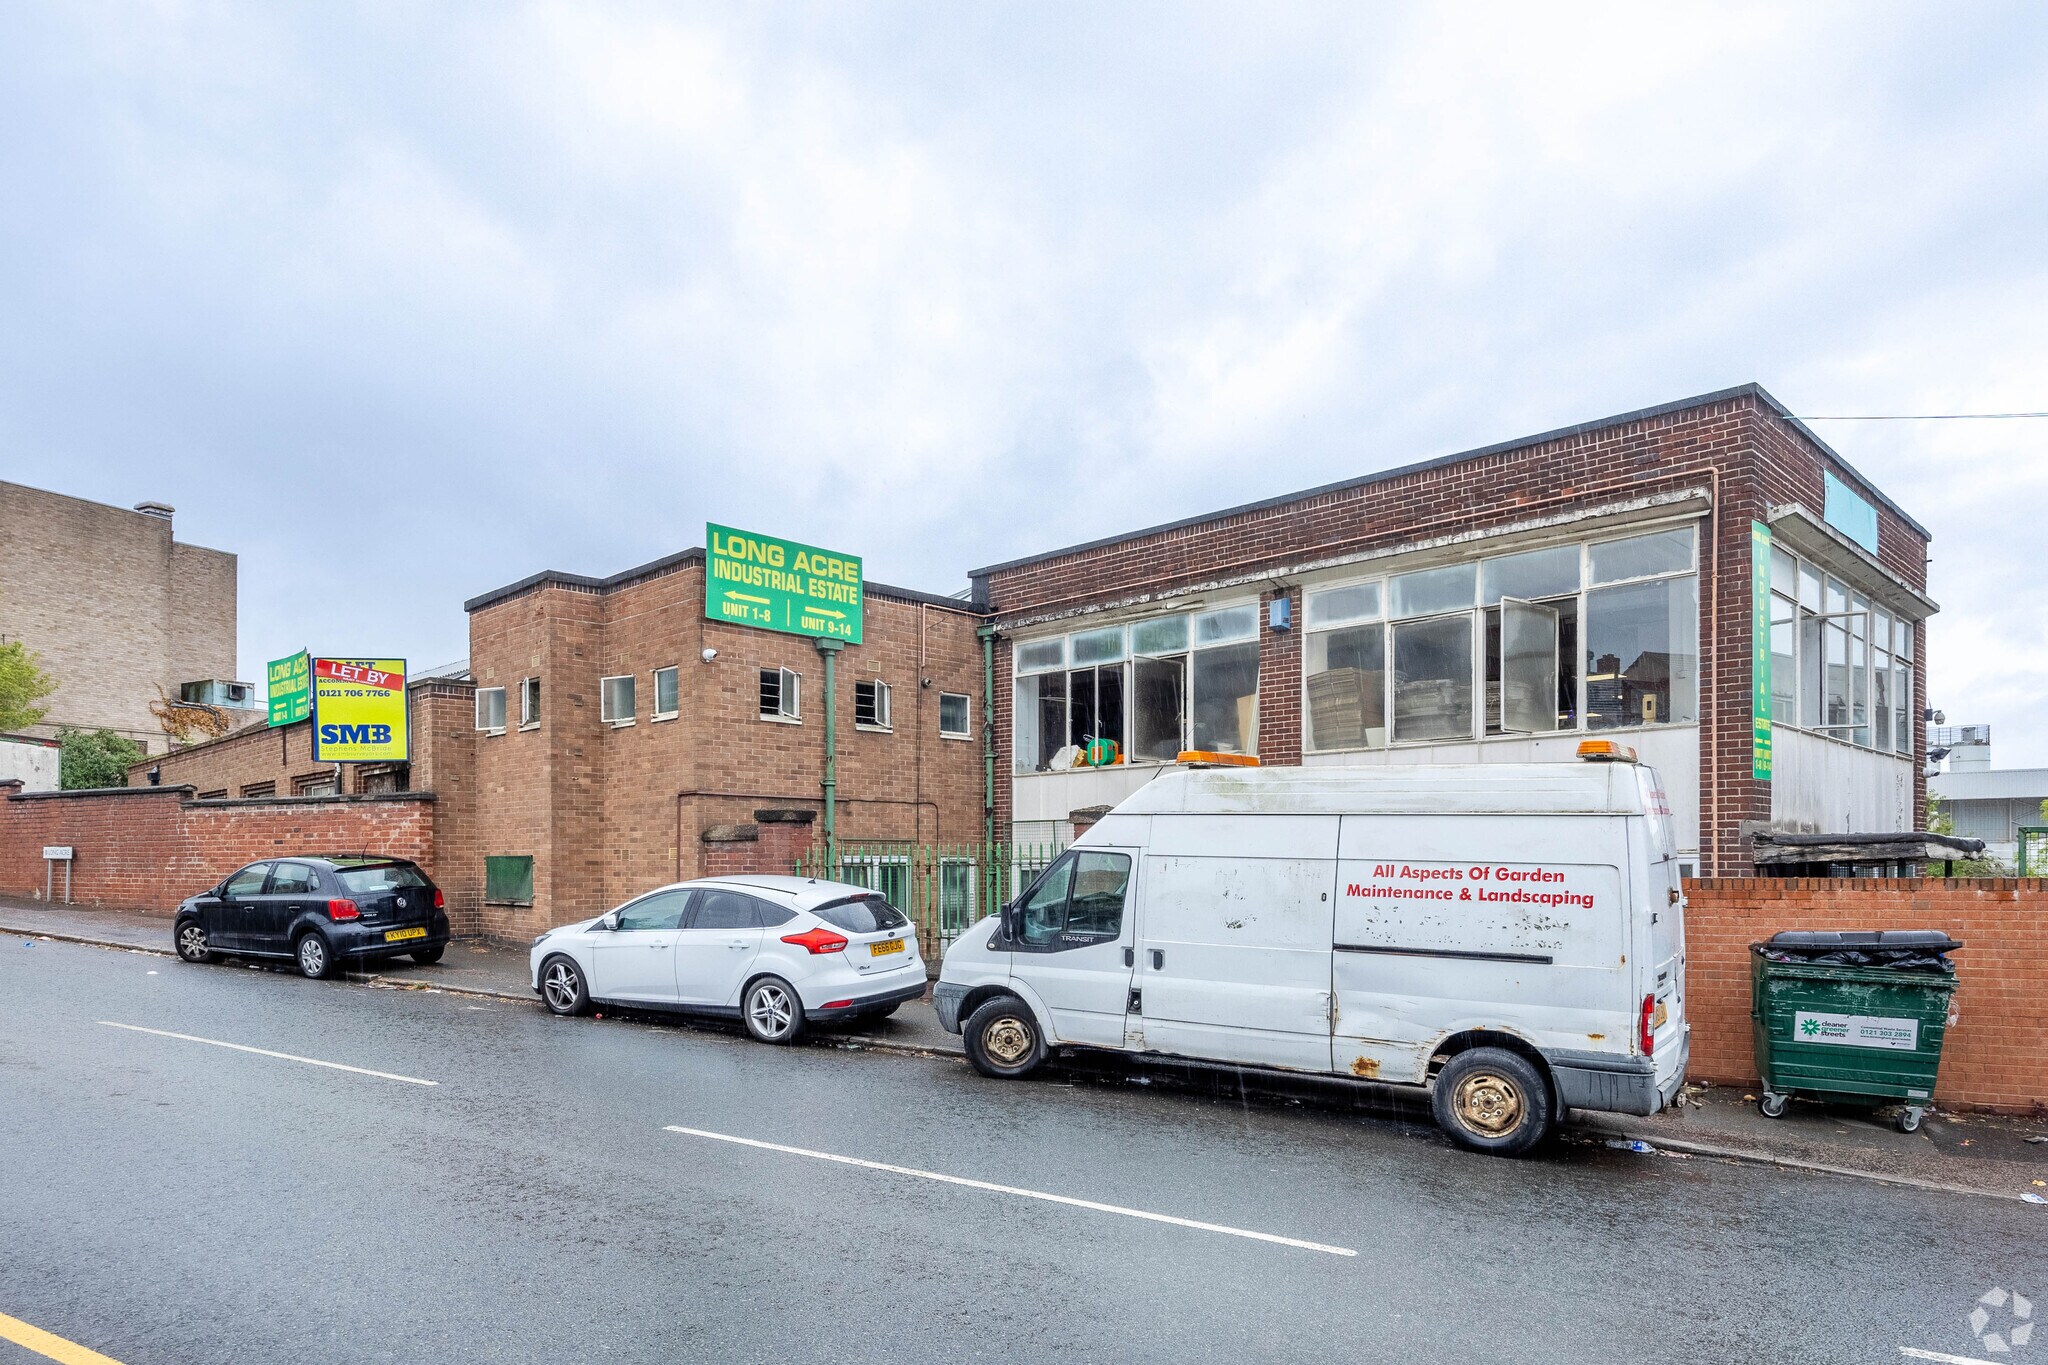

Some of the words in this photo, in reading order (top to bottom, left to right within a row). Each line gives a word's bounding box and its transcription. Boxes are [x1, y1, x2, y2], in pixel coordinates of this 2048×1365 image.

[713, 532, 785, 567] LONG
[792, 551, 858, 583] ACRE
[714, 558, 804, 594] INDUSTRIAL
[808, 577, 858, 605] ESTATE
[722, 601, 749, 618] UNIT
[752, 607, 771, 622] 1-8
[801, 615, 825, 632] UNIT
[827, 621, 851, 636] 9-14
[1757, 547, 1766, 712] INDUSTRIAL
[269, 661, 291, 682] LONG
[330, 663, 363, 680] LET
[366, 670, 389, 684] BY
[319, 689, 342, 697] 0121
[344, 689, 363, 697] 706
[366, 689, 391, 697] 7766
[320, 724, 392, 745] SMB
[1373, 864, 1395, 878] All
[1399, 865, 1464, 882] Aspects
[1468, 866, 1490, 881] Of
[1495, 867, 1565, 883] Garden
[1346, 884, 1453, 901] Maintenance
[1458, 887, 1472, 901] &
[1478, 887, 1594, 909] Landscaping
[1821, 1020, 1848, 1028] cleaner
[1821, 1026, 1850, 1034] greener
